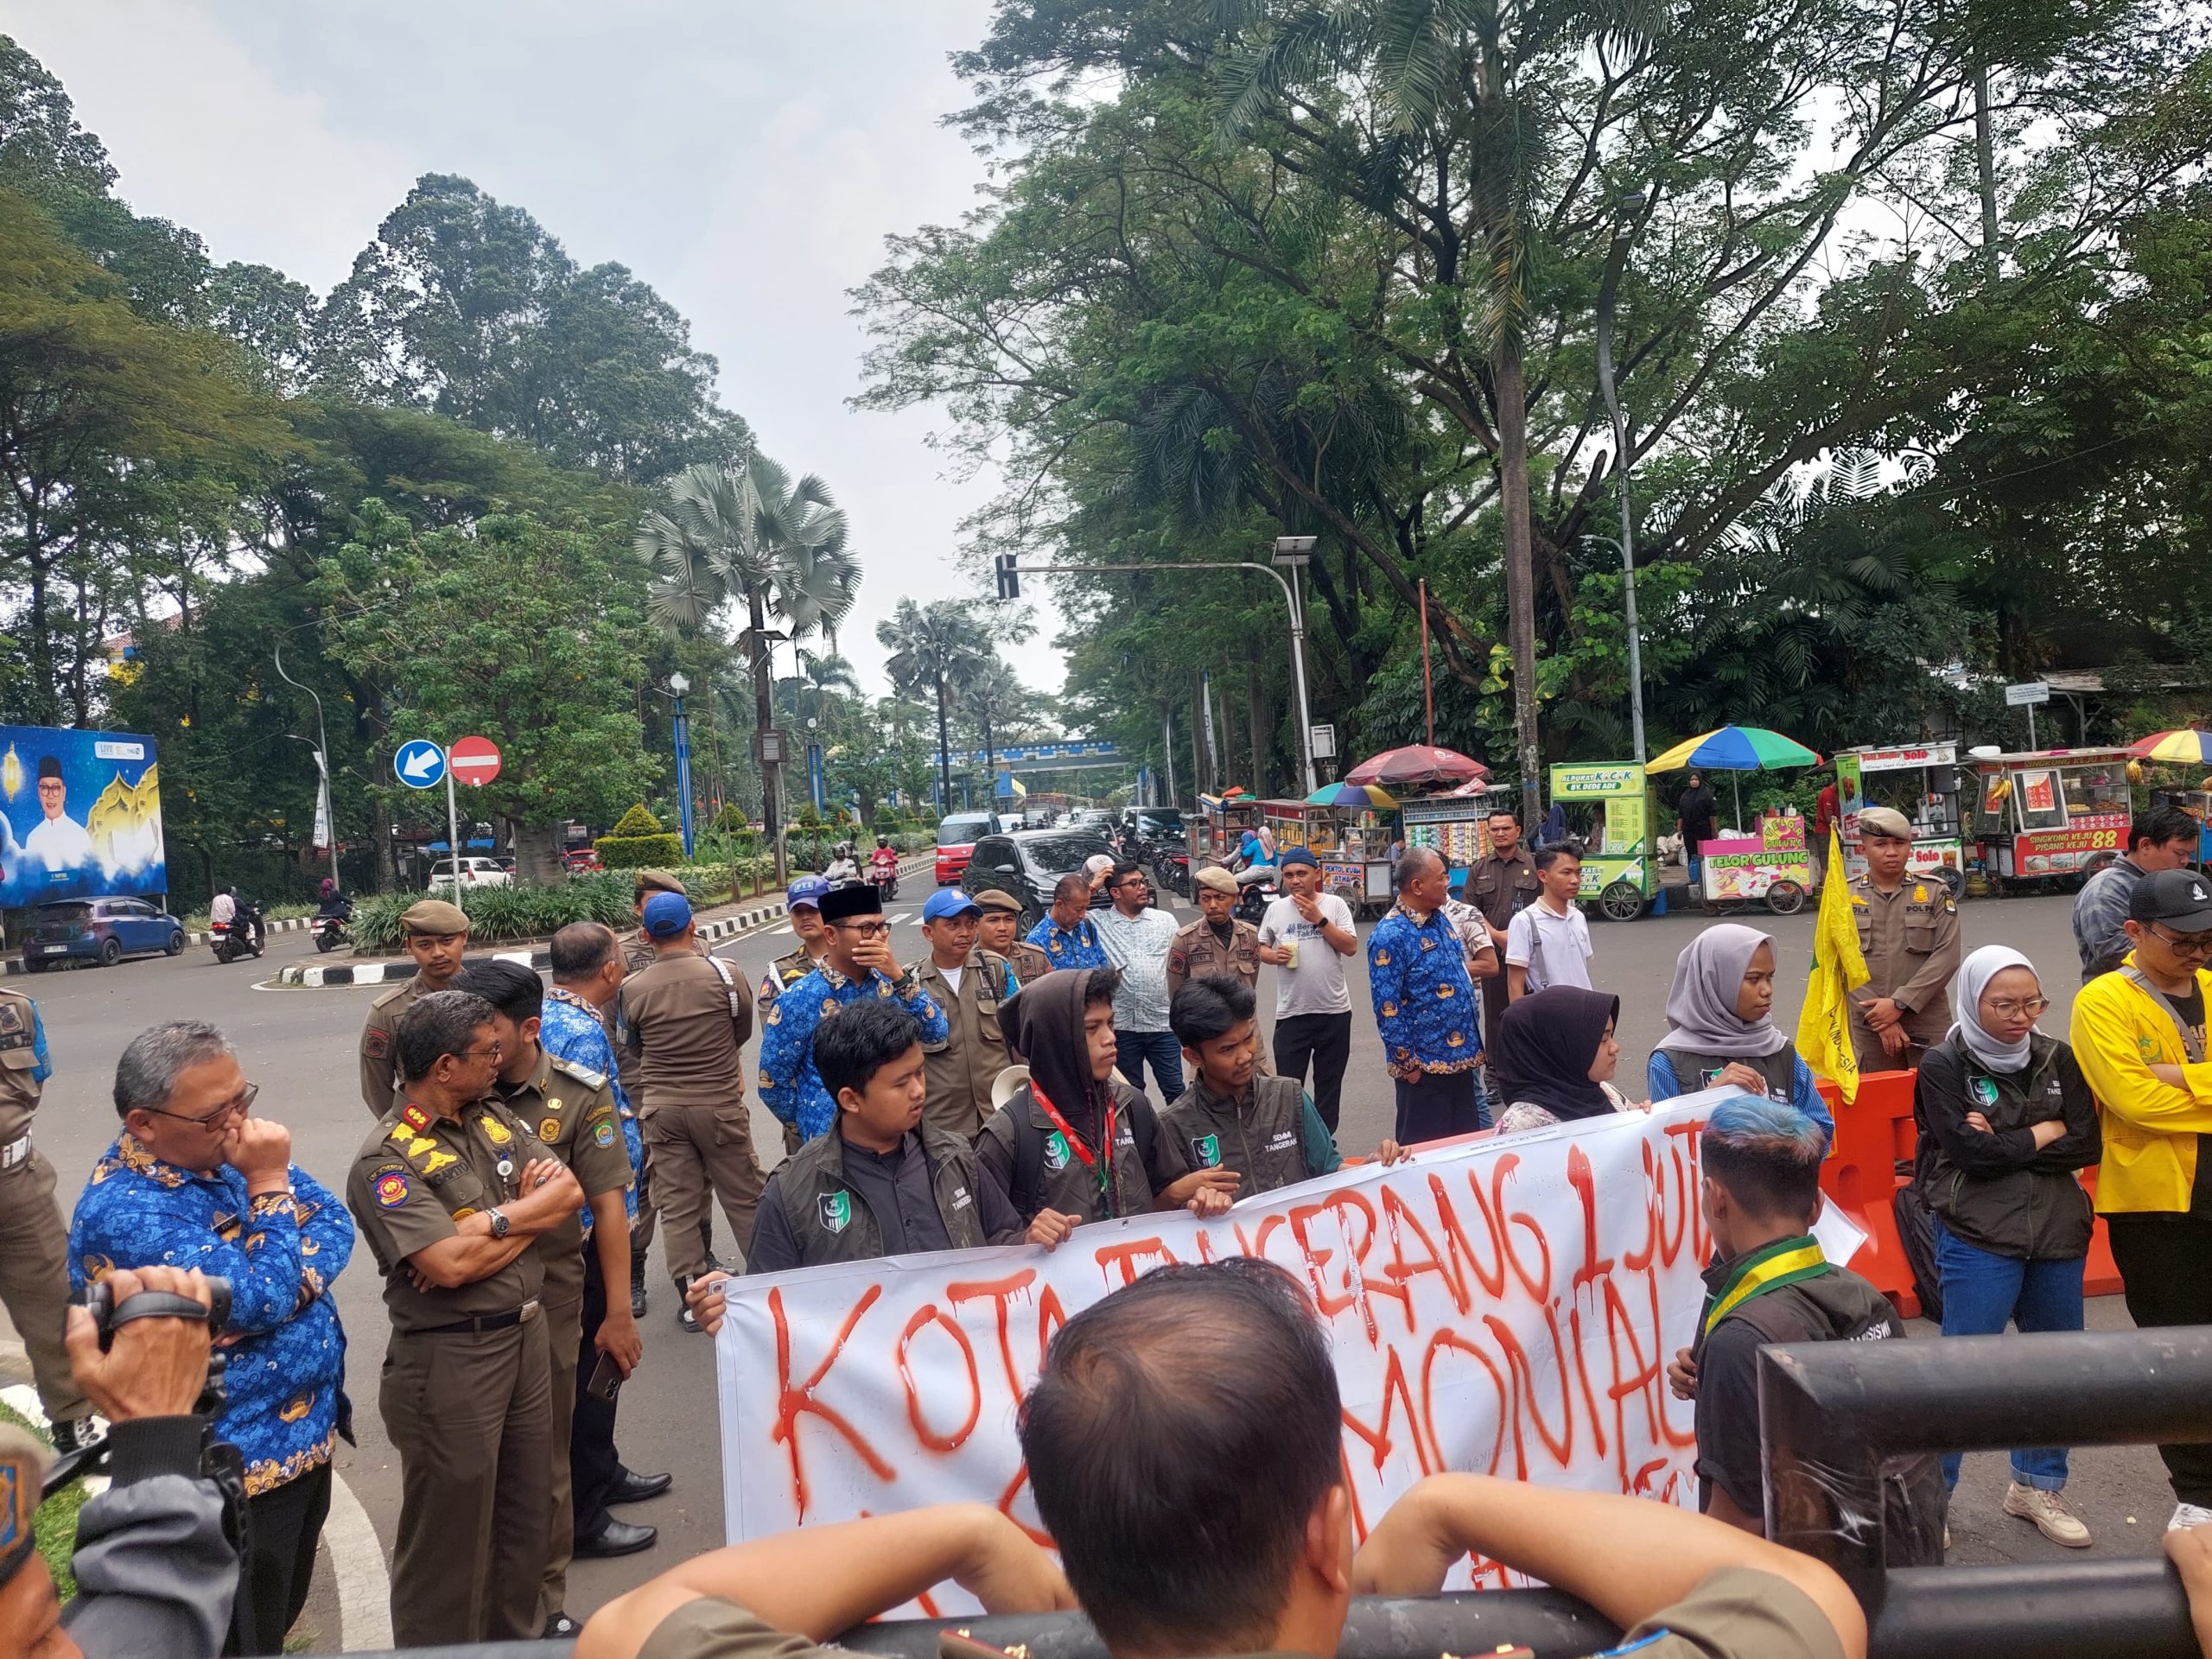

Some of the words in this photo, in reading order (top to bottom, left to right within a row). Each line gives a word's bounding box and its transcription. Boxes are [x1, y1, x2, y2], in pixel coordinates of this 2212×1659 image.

[1903, 749, 1928, 760] Solo
[2024, 760, 2070, 768] SINGKONG
[1765, 819, 1802, 837] TELOR
[1765, 839, 1803, 849] GULUNG
[2030, 834, 2069, 844] SINGKONG
[2072, 831, 2093, 841] KEJU
[2092, 830, 2118, 849] 88
[2067, 841, 2088, 849] KEJU
[1709, 855, 1750, 868] TELOR
[1751, 851, 1808, 866] GULUNG
[1916, 849, 1940, 862] Solo
[1325, 865, 1344, 874] PENTOL
[1273, 1130, 1292, 1141] SEMMI
[1264, 1138, 1297, 1153] TANGERAN
[1624, 1121, 1713, 1271] JUT
